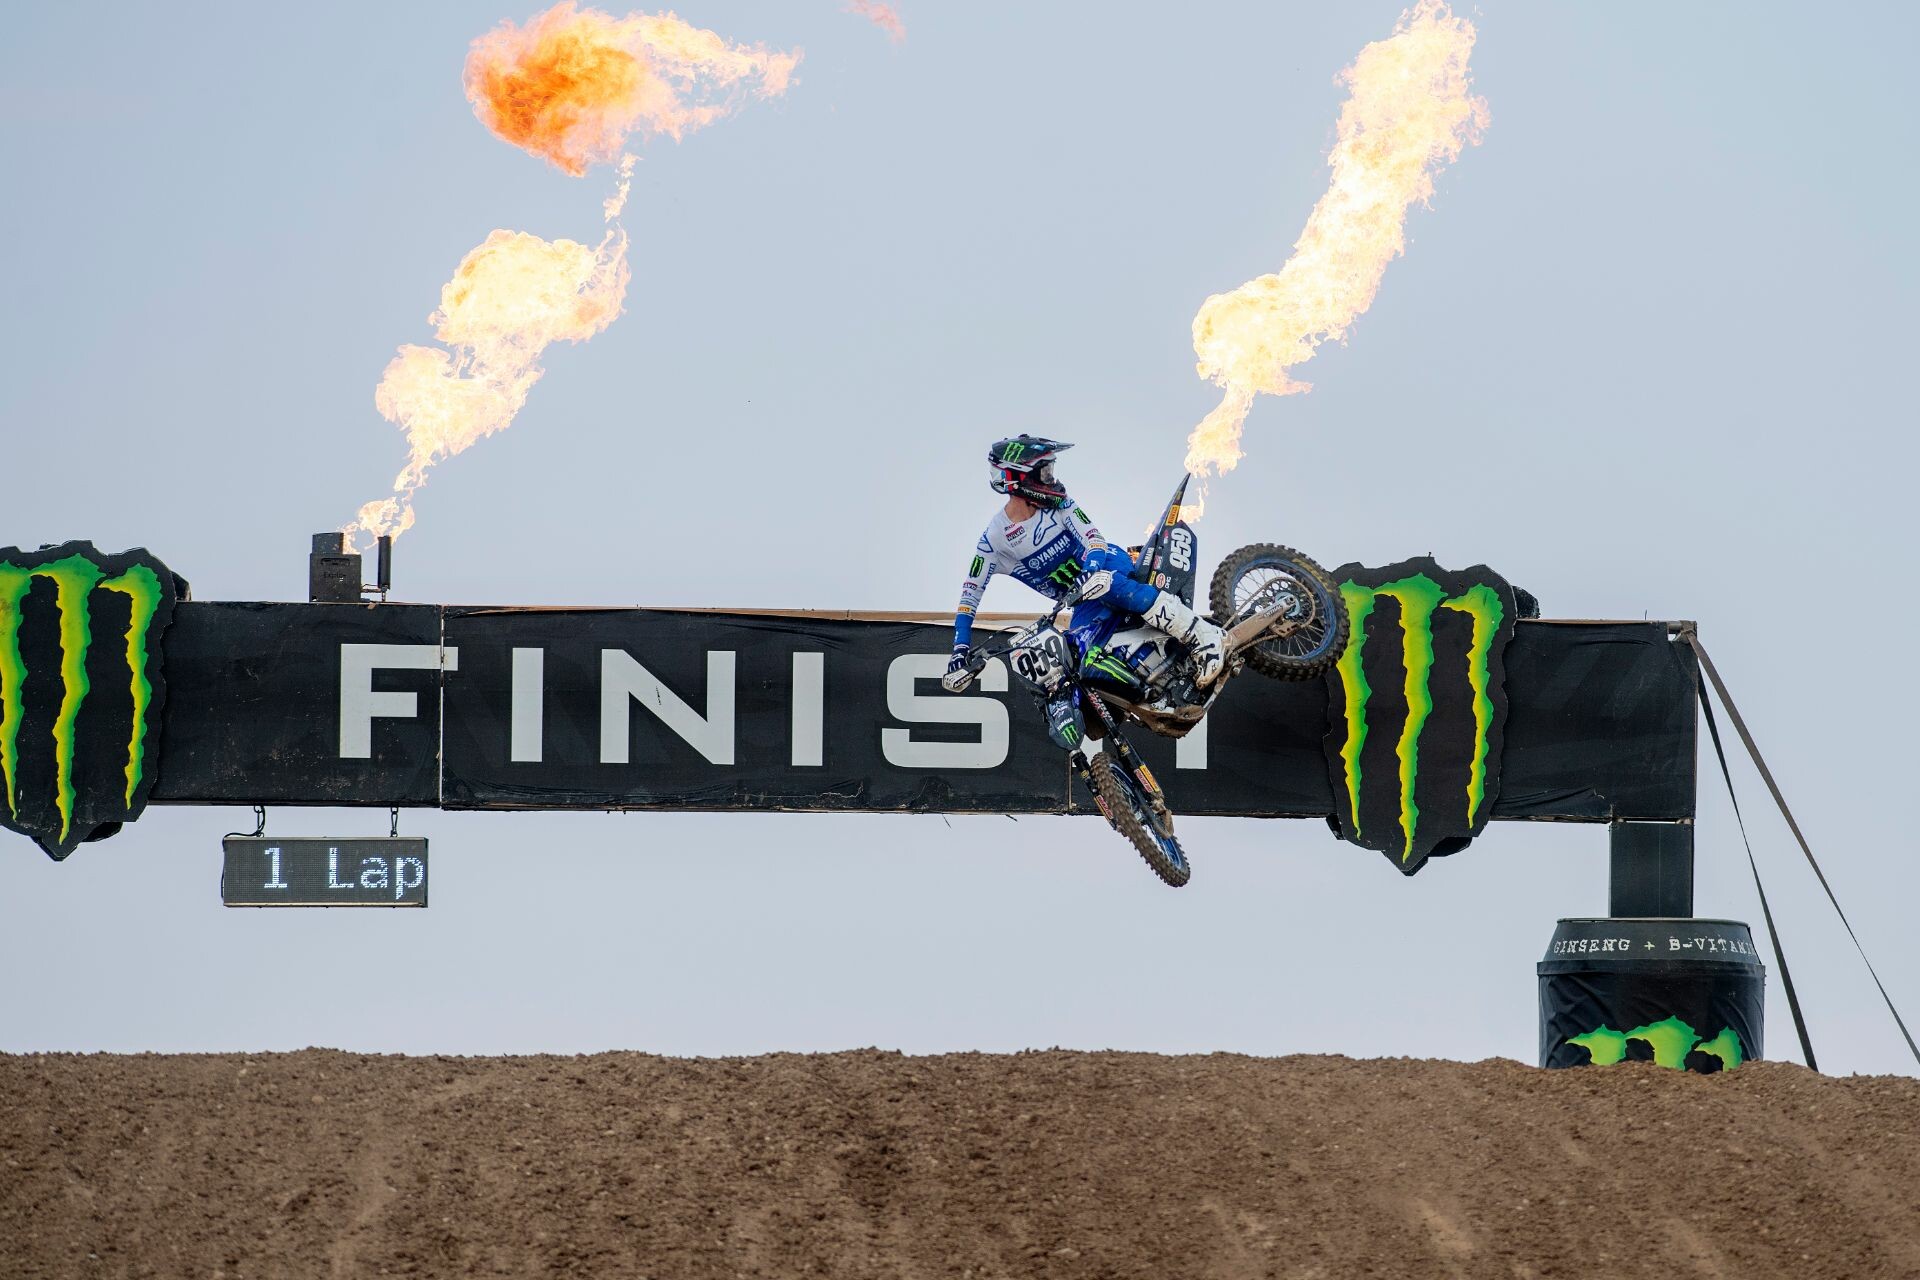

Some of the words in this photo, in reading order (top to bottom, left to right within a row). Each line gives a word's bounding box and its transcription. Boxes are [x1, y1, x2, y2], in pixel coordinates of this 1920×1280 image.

[1037, 535, 1071, 563] YAMAHA
[1170, 527, 1192, 572] 959
[1017, 635, 1065, 682] 959
[340, 643, 1207, 770] FINIS
[264, 847, 288, 888] 1
[328, 847, 424, 900] Lap
[1553, 938, 1631, 954] GINSENG
